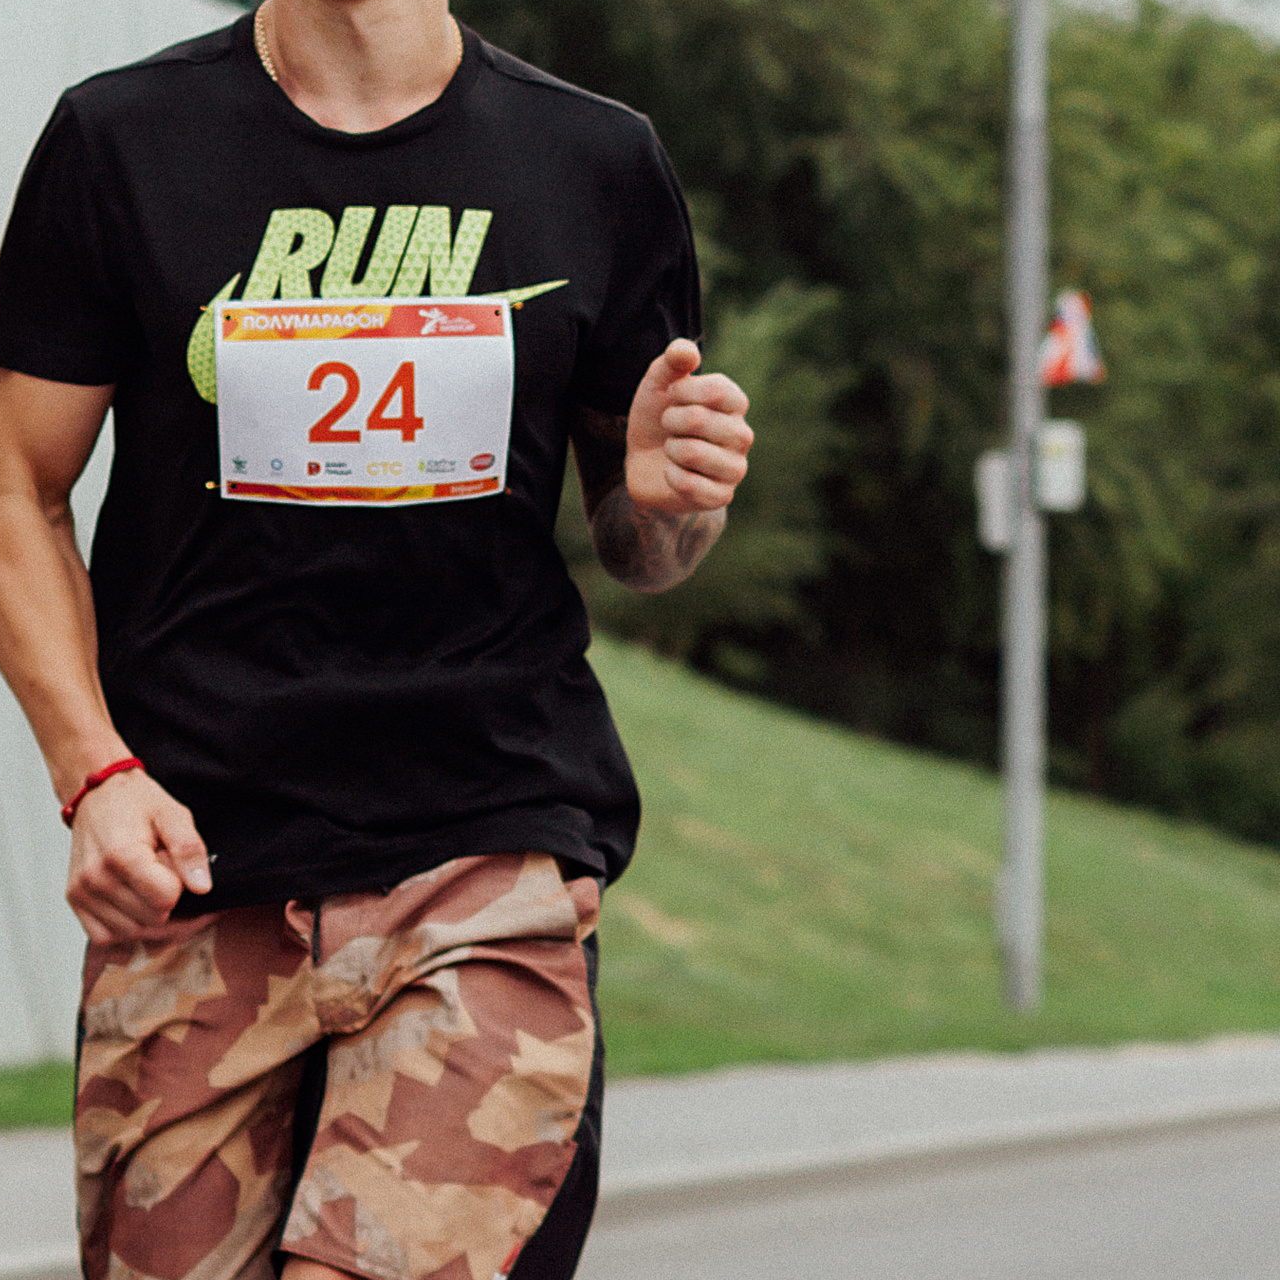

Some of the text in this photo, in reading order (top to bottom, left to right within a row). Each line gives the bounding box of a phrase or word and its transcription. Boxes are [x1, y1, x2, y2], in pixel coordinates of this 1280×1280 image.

[241, 205, 493, 299] RUN
[242, 313, 385, 331] ПОЛУМАРАФОН
[307, 361, 424, 443] 24
